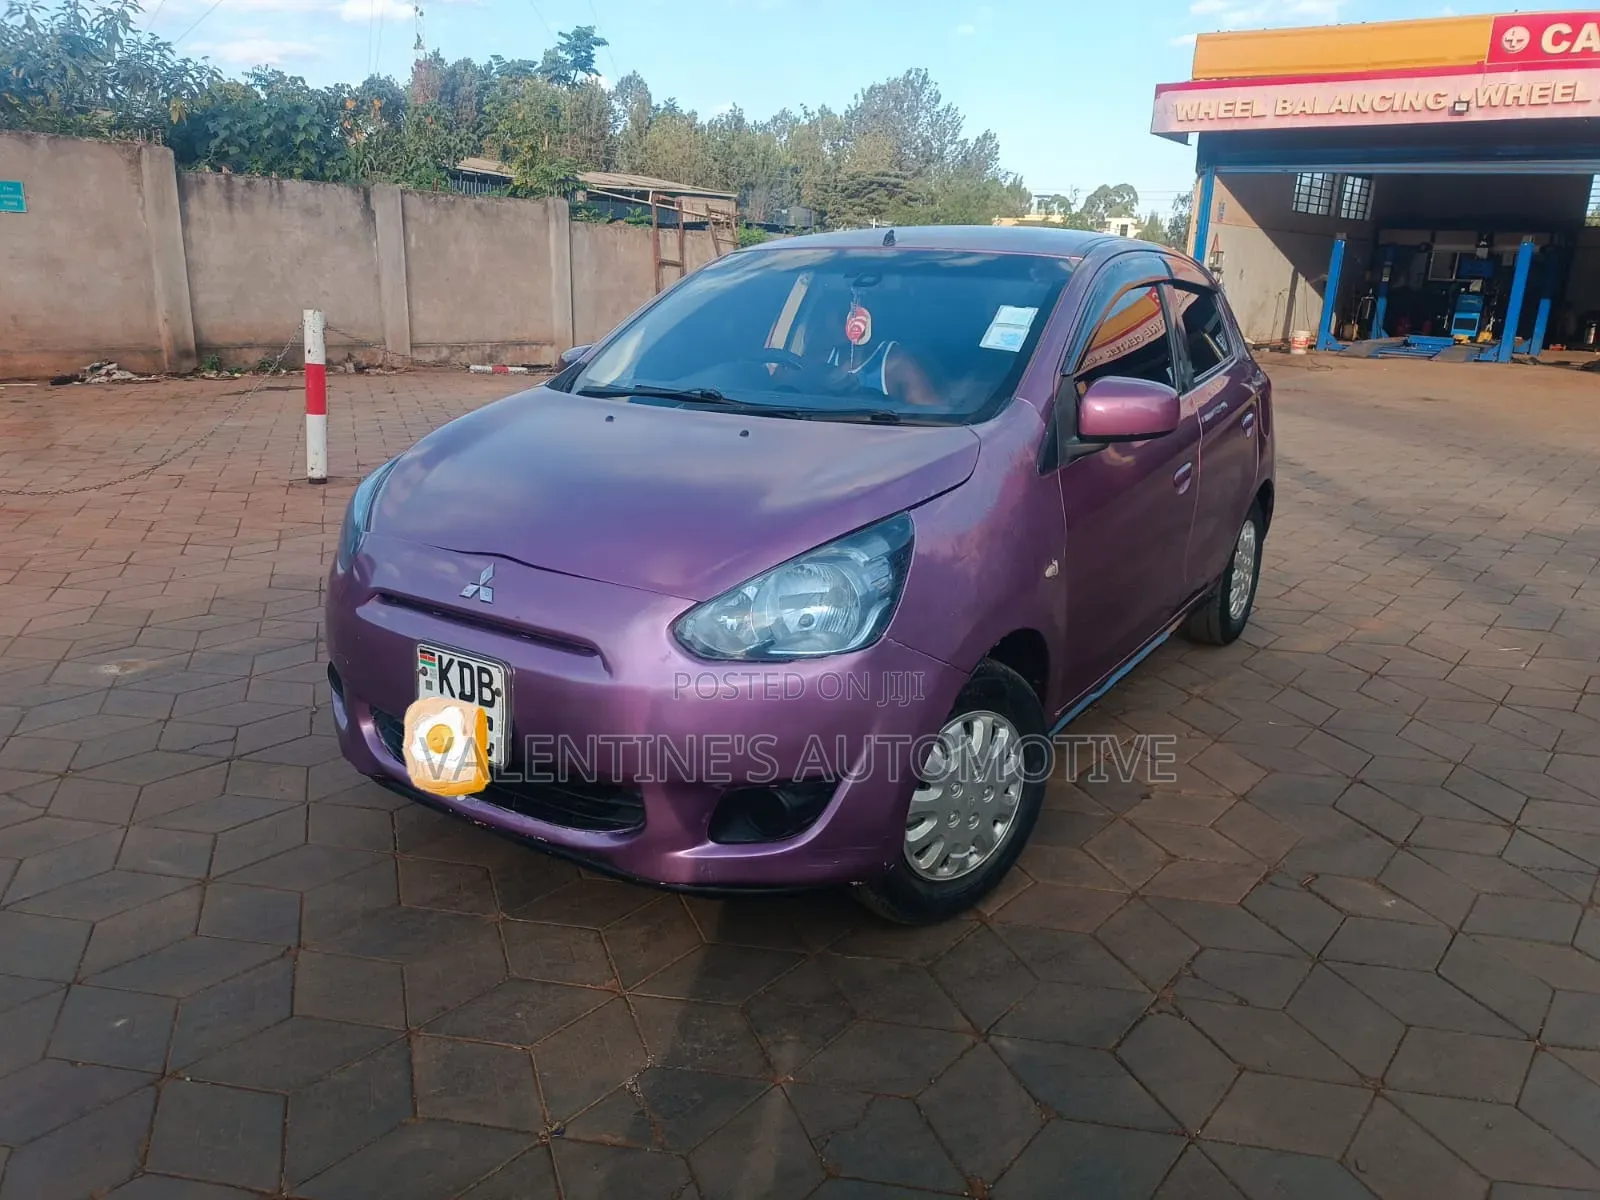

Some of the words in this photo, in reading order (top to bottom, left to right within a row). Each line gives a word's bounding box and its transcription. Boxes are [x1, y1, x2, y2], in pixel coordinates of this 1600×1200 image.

[1175, 99, 1268, 121] WHEEL
[1275, 90, 1448, 116] BALANCING
[1476, 80, 1593, 108] WHEEL
[437, 654, 496, 708] KDB
